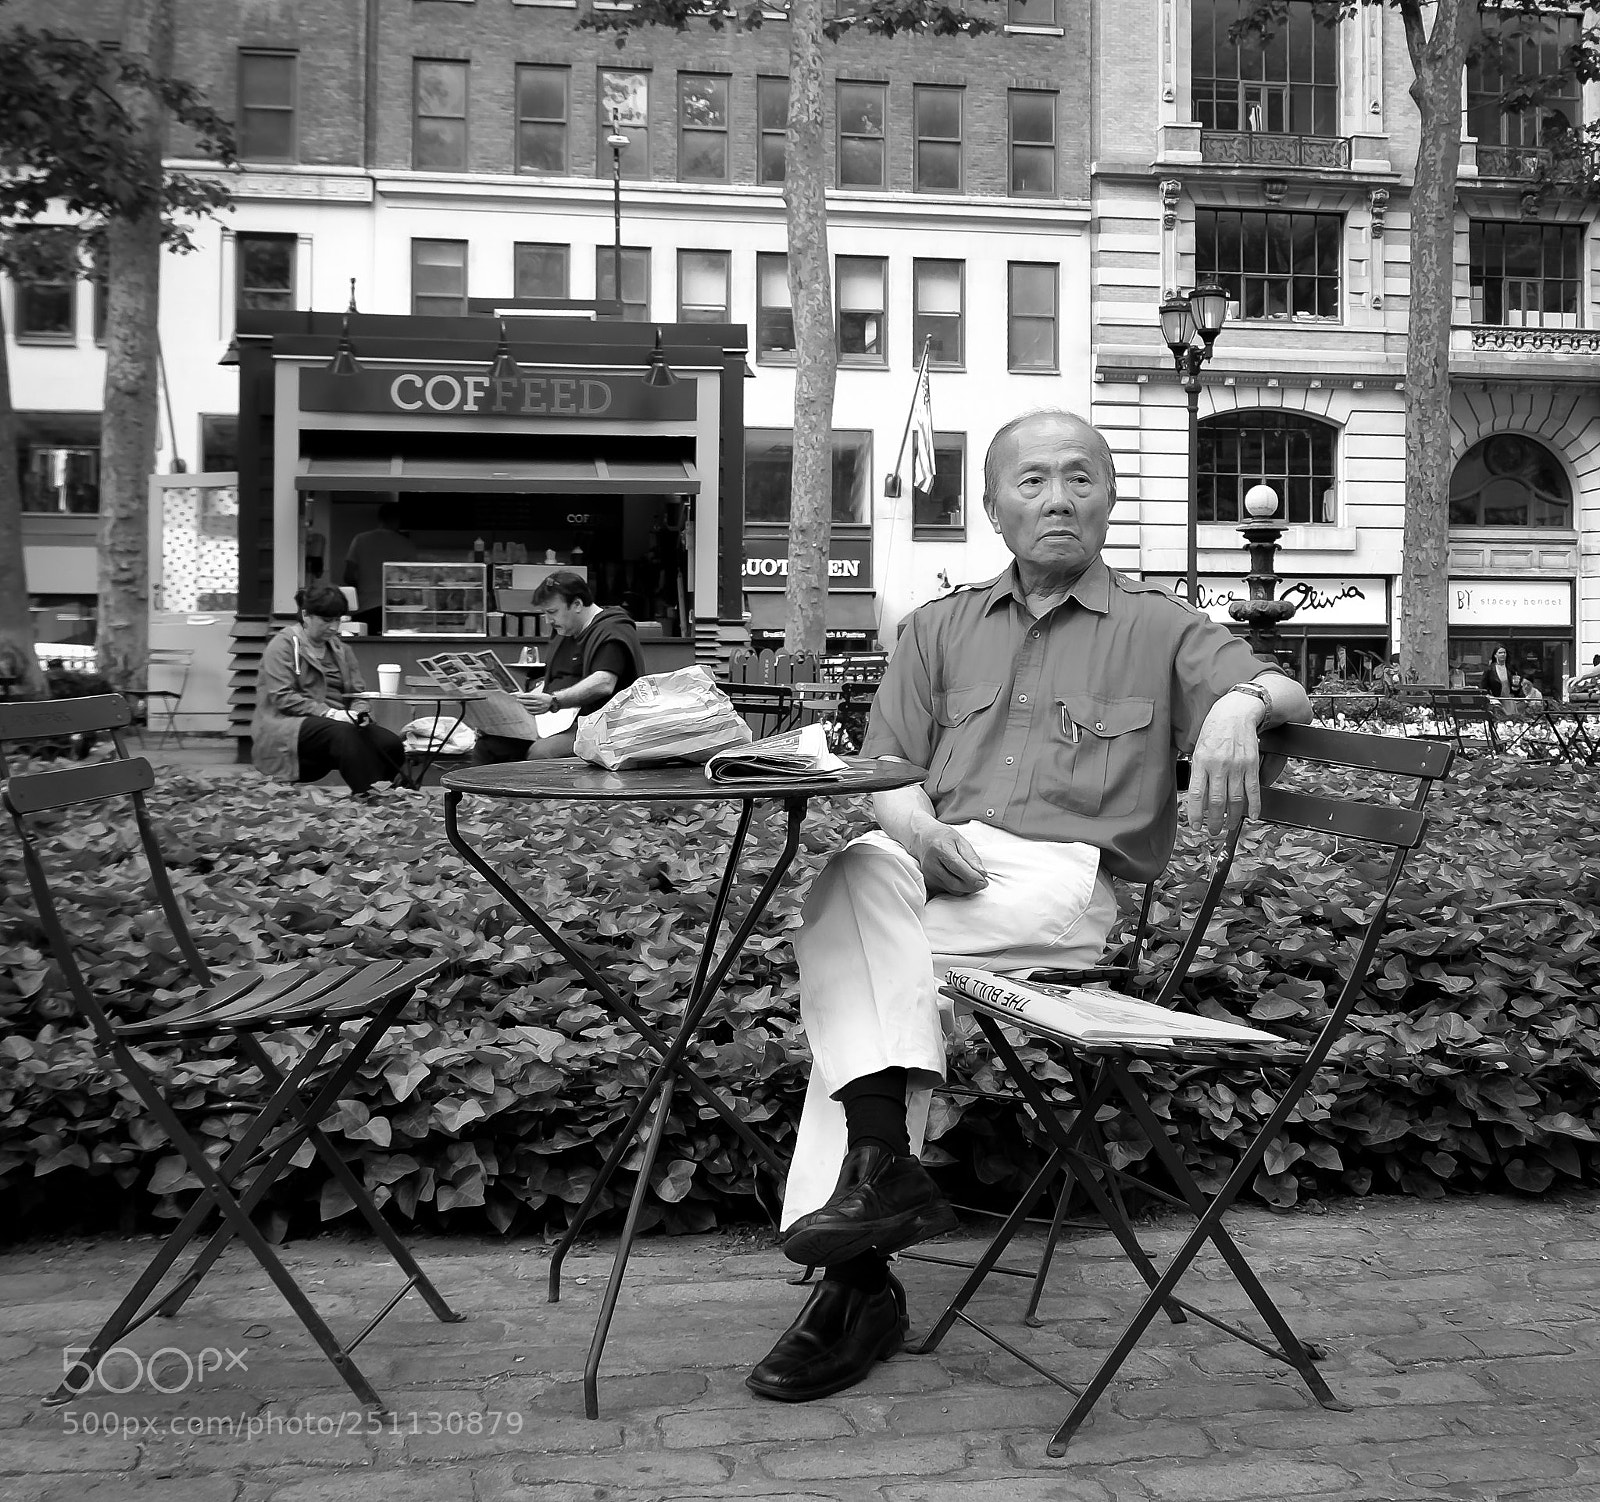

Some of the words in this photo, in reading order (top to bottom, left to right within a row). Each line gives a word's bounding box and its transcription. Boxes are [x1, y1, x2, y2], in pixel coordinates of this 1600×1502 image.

[390, 373, 612, 414] COFFEED
[1280, 582, 1366, 610] Olivia
[1480, 598, 1518, 606] stacey
[973, 979, 1005, 1002] BULL
[1000, 992, 1031, 1013] THE
